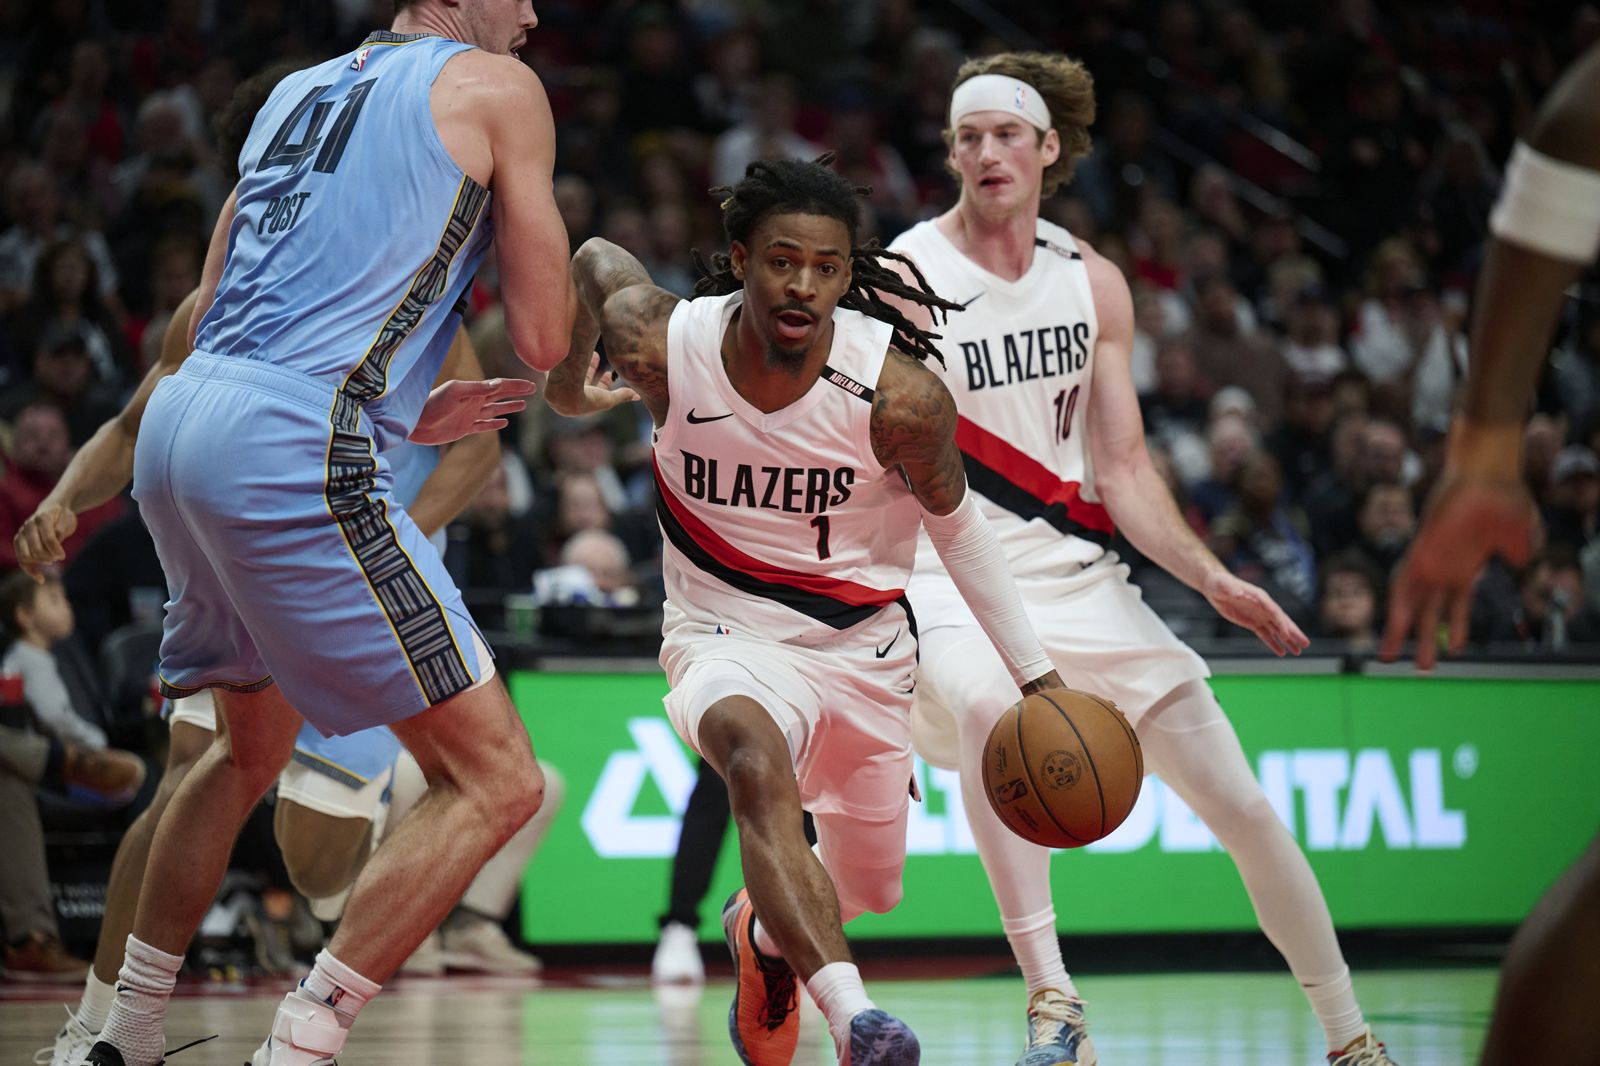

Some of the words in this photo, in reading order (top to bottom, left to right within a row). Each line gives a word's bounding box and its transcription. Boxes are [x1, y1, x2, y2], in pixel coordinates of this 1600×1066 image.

[255, 77, 378, 177] 41
[258, 191, 311, 235] POST
[829, 372, 865, 396] ADELMAN
[959, 322, 1088, 391] BLAZERS
[1054, 384, 1080, 446] 10
[680, 449, 855, 514] BLAZERS
[810, 515, 831, 561] 1
